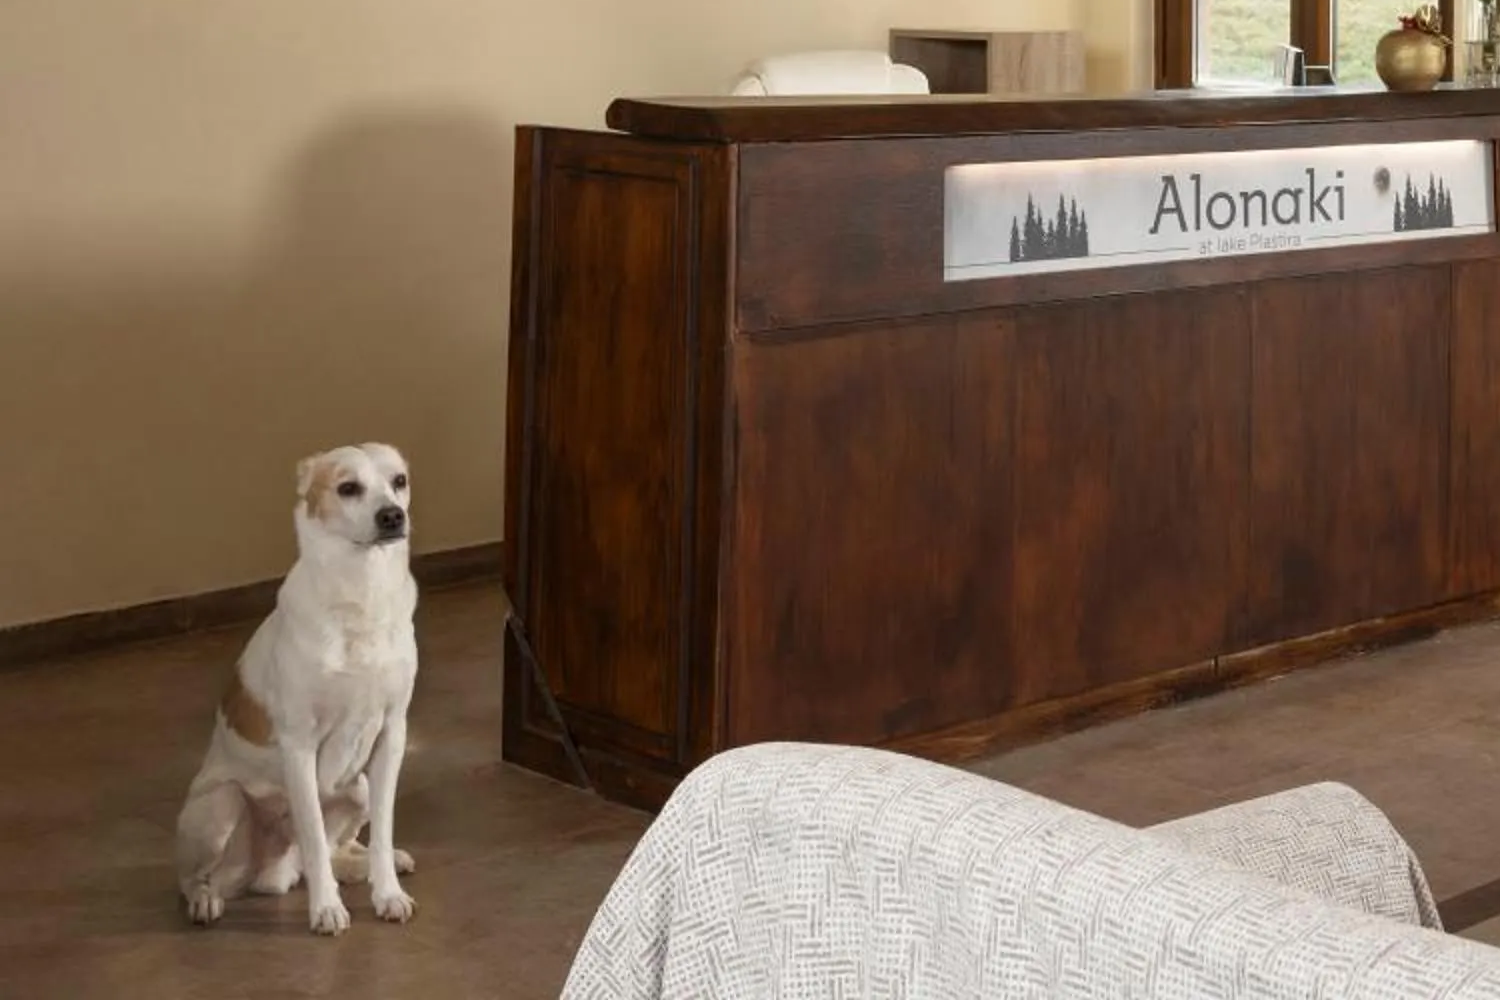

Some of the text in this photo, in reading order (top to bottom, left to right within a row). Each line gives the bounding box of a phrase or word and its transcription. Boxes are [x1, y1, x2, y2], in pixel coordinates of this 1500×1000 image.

[1149, 167, 1345, 235] Alonaki
[1199, 239, 1213, 255] at
[1217, 235, 1247, 253] lake
